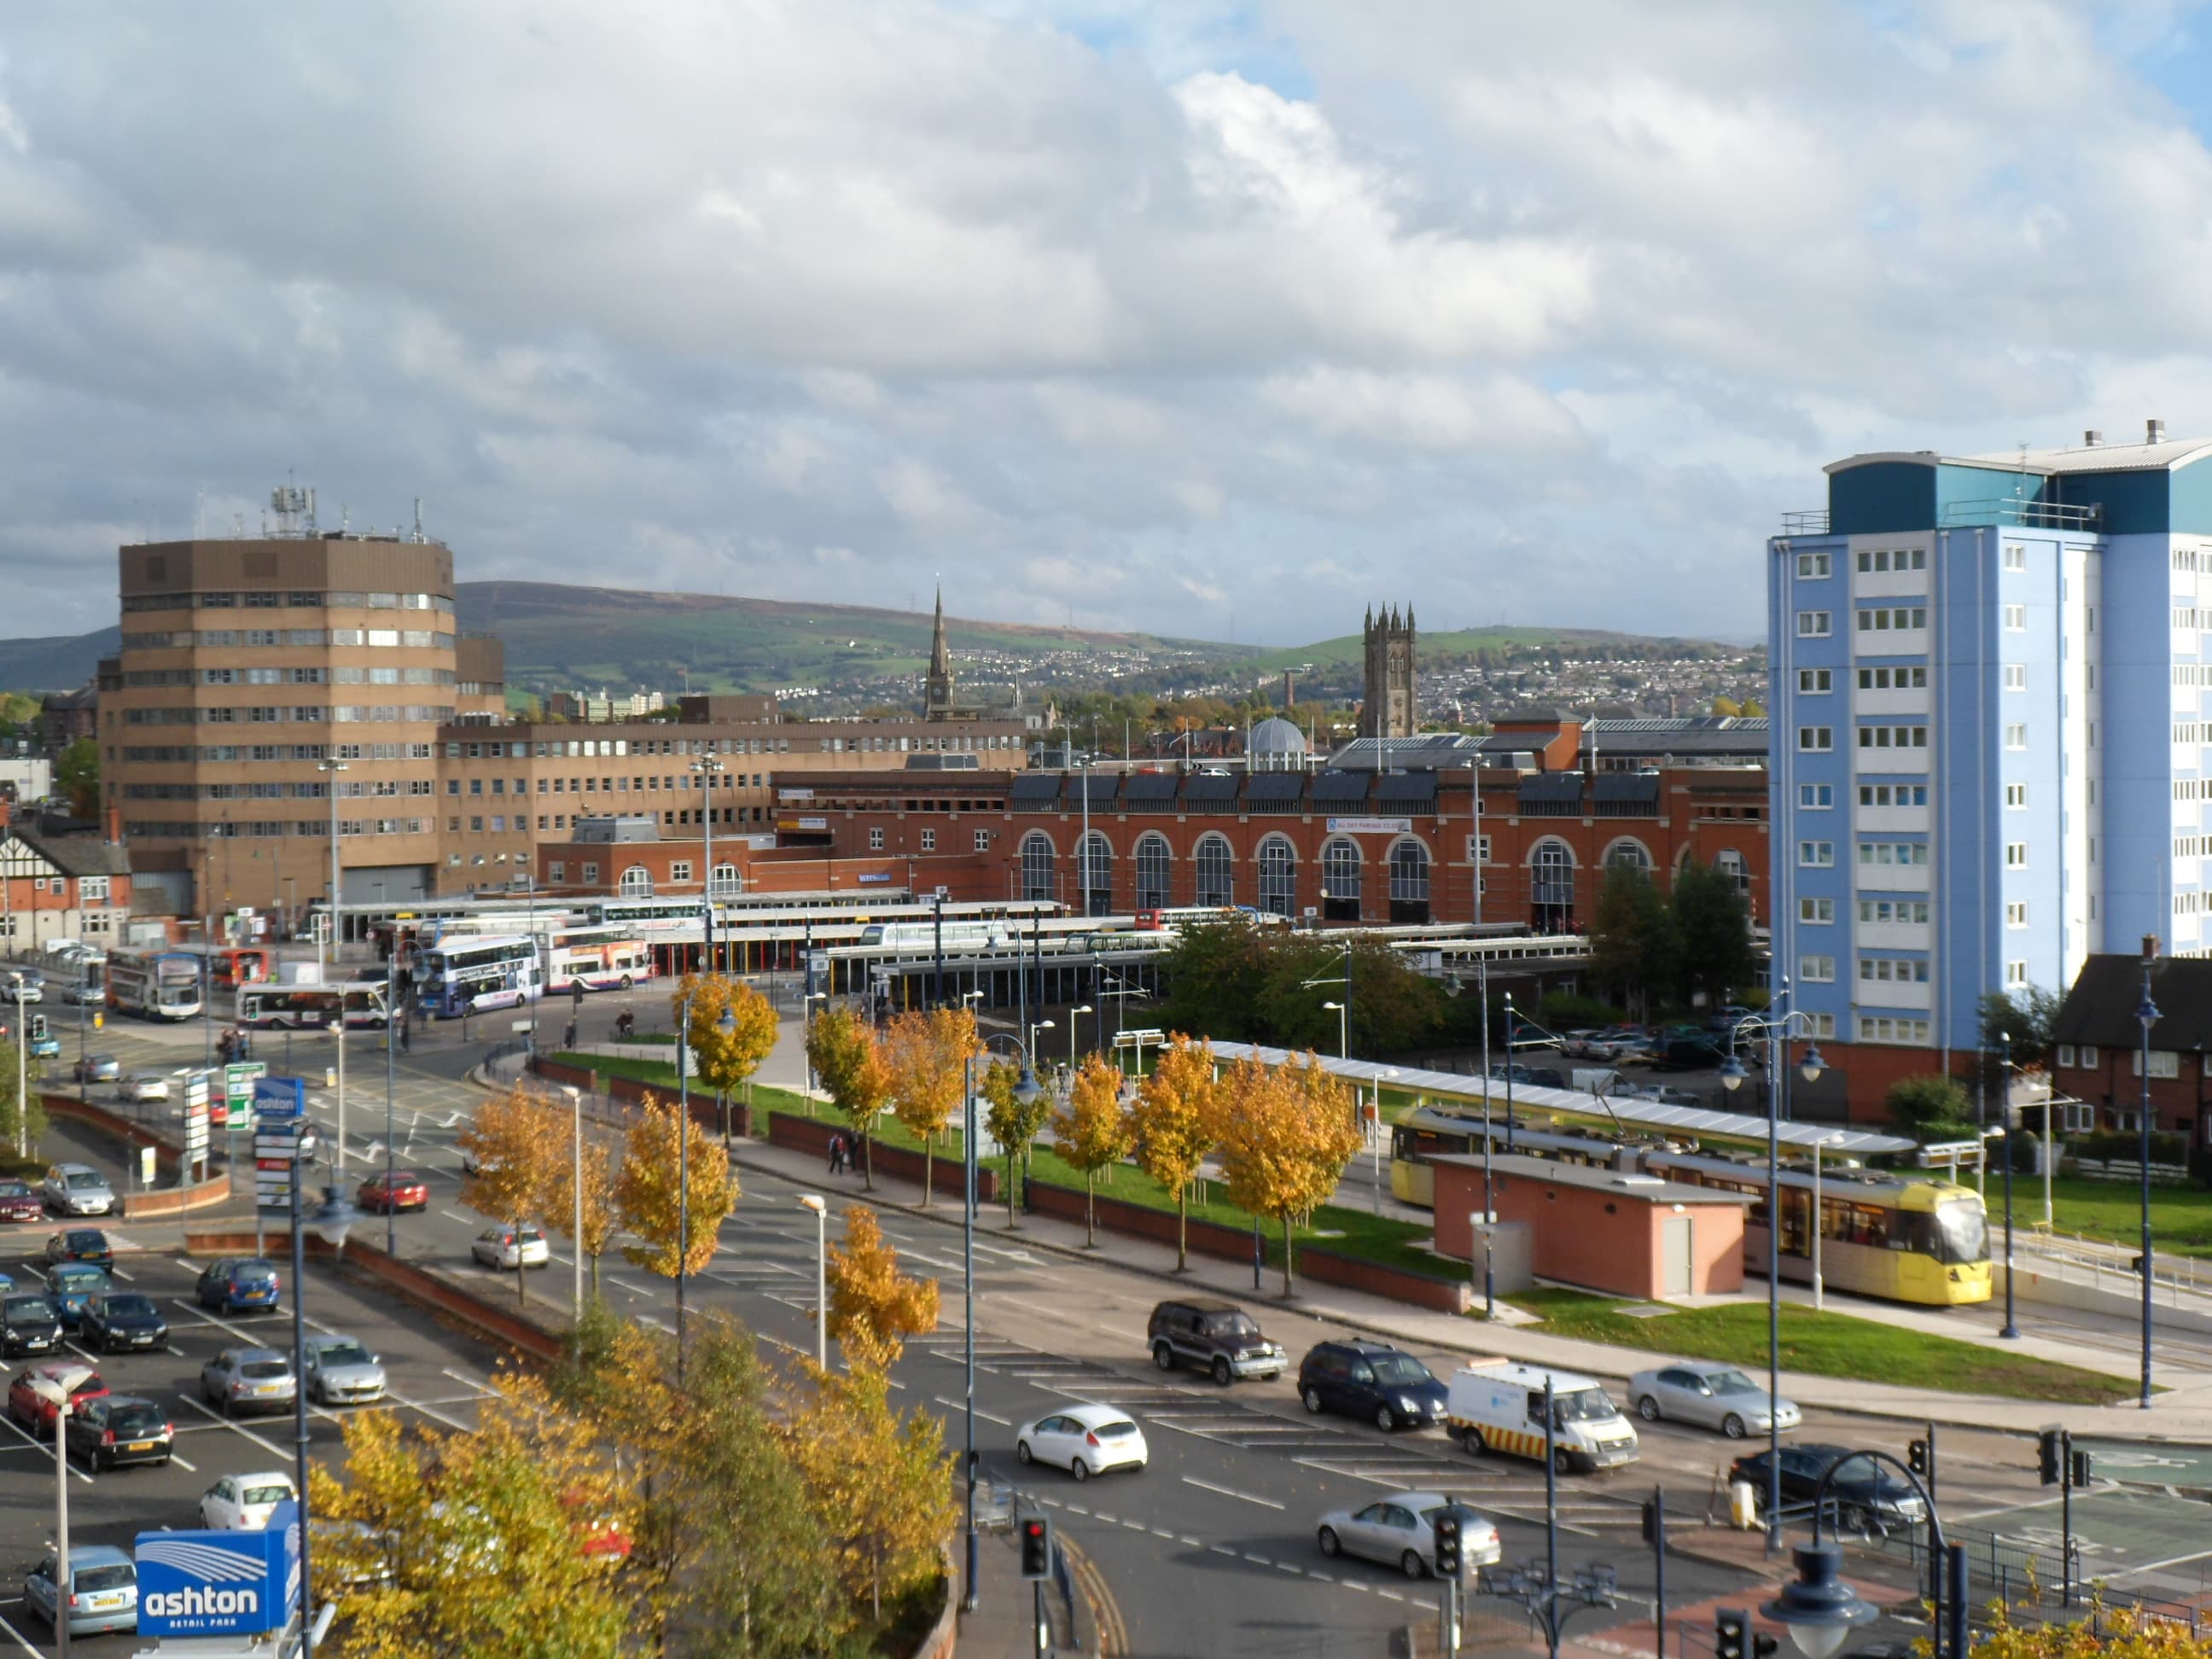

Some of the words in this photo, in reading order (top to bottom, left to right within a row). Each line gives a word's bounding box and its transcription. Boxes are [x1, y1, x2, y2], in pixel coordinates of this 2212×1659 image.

[255, 1097, 294, 1110] ashton
[145, 1586, 258, 1617] ashton
[170, 1618, 205, 1628] RETAIL
[210, 1617, 236, 1627] PARK
